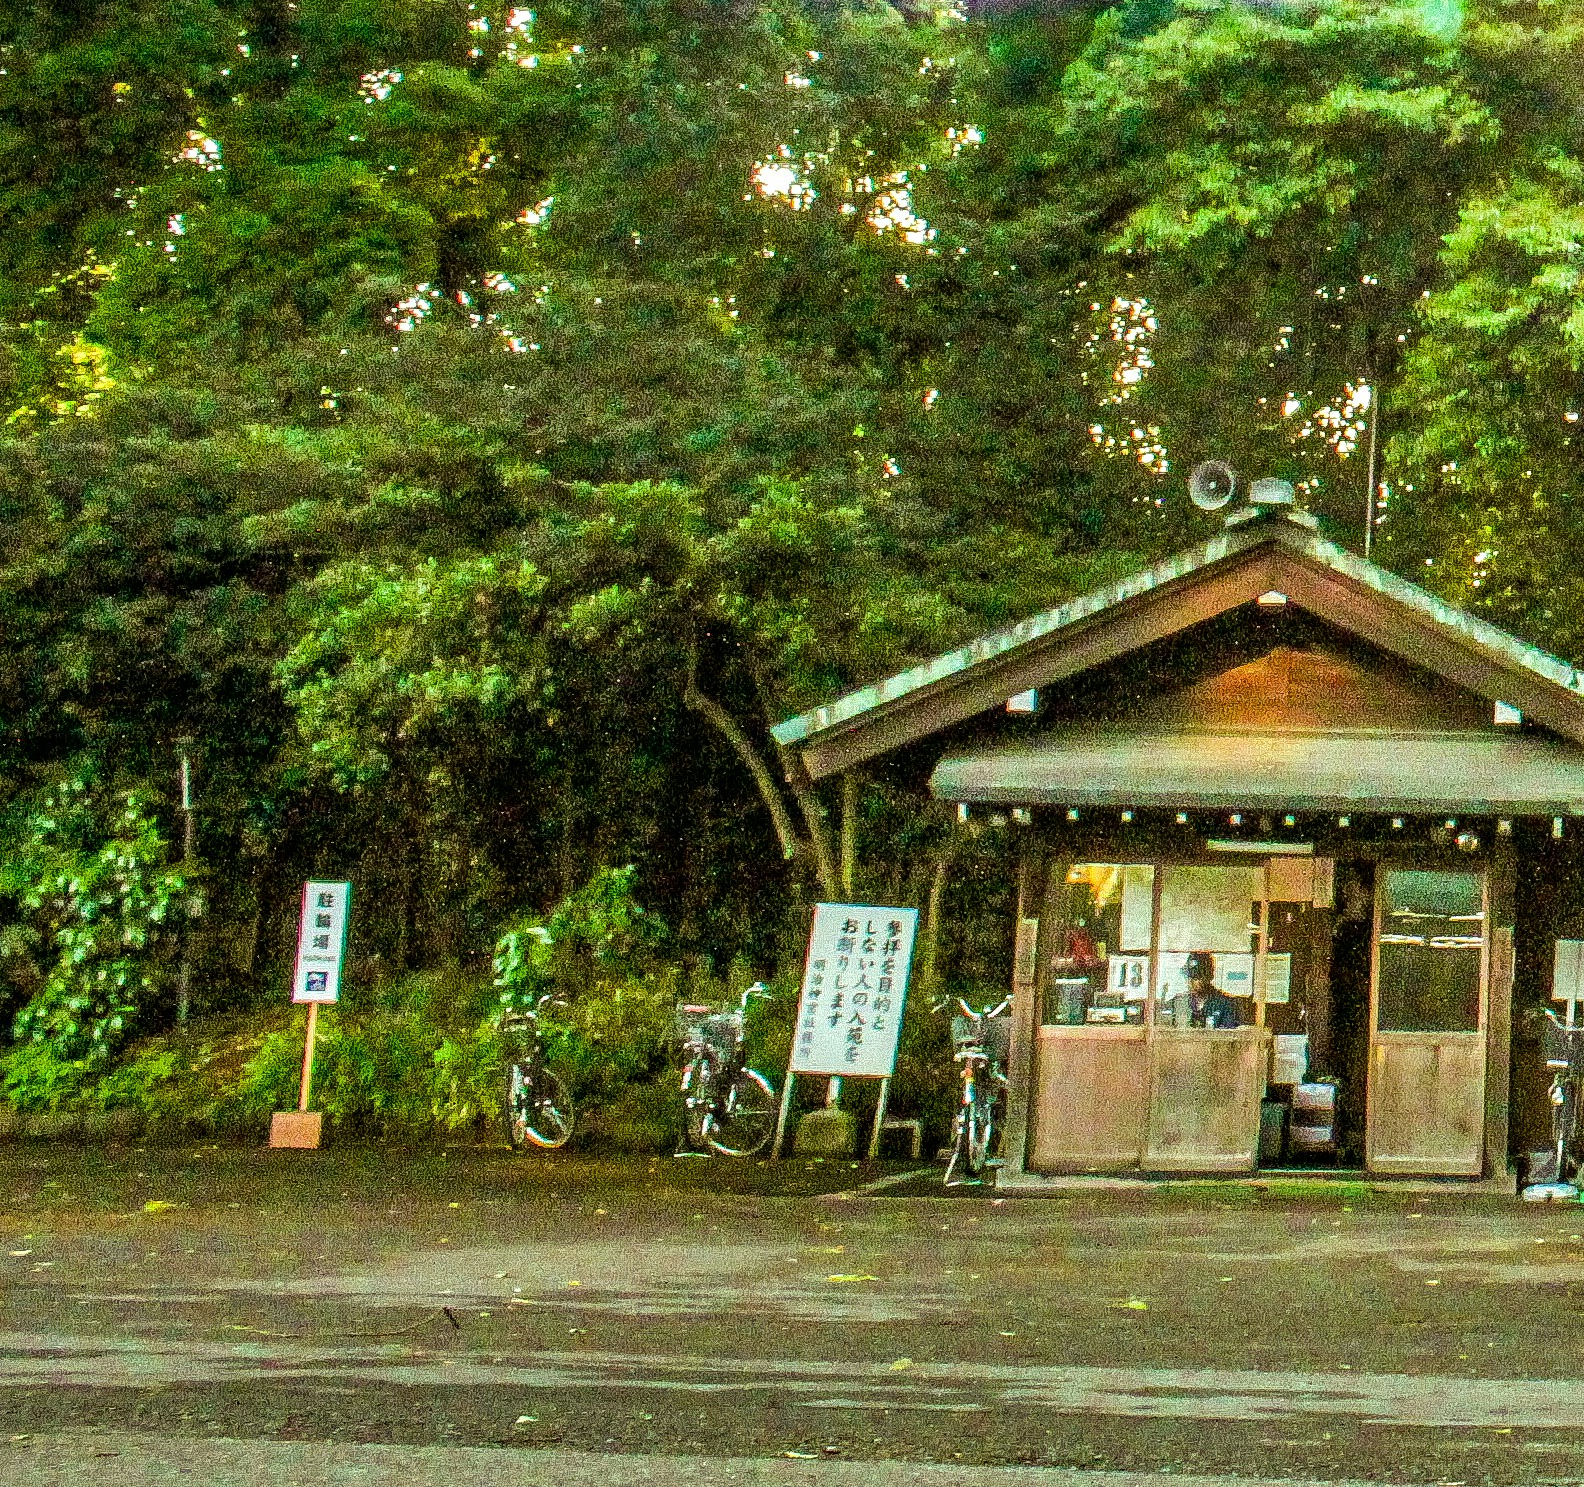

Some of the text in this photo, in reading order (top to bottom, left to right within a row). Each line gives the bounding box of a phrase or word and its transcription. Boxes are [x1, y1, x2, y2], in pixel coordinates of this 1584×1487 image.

[312, 891, 334, 950] 駐輪場
[828, 918, 858, 1028] お断りします
[872, 919, 902, 1030] 参拝を目的と
